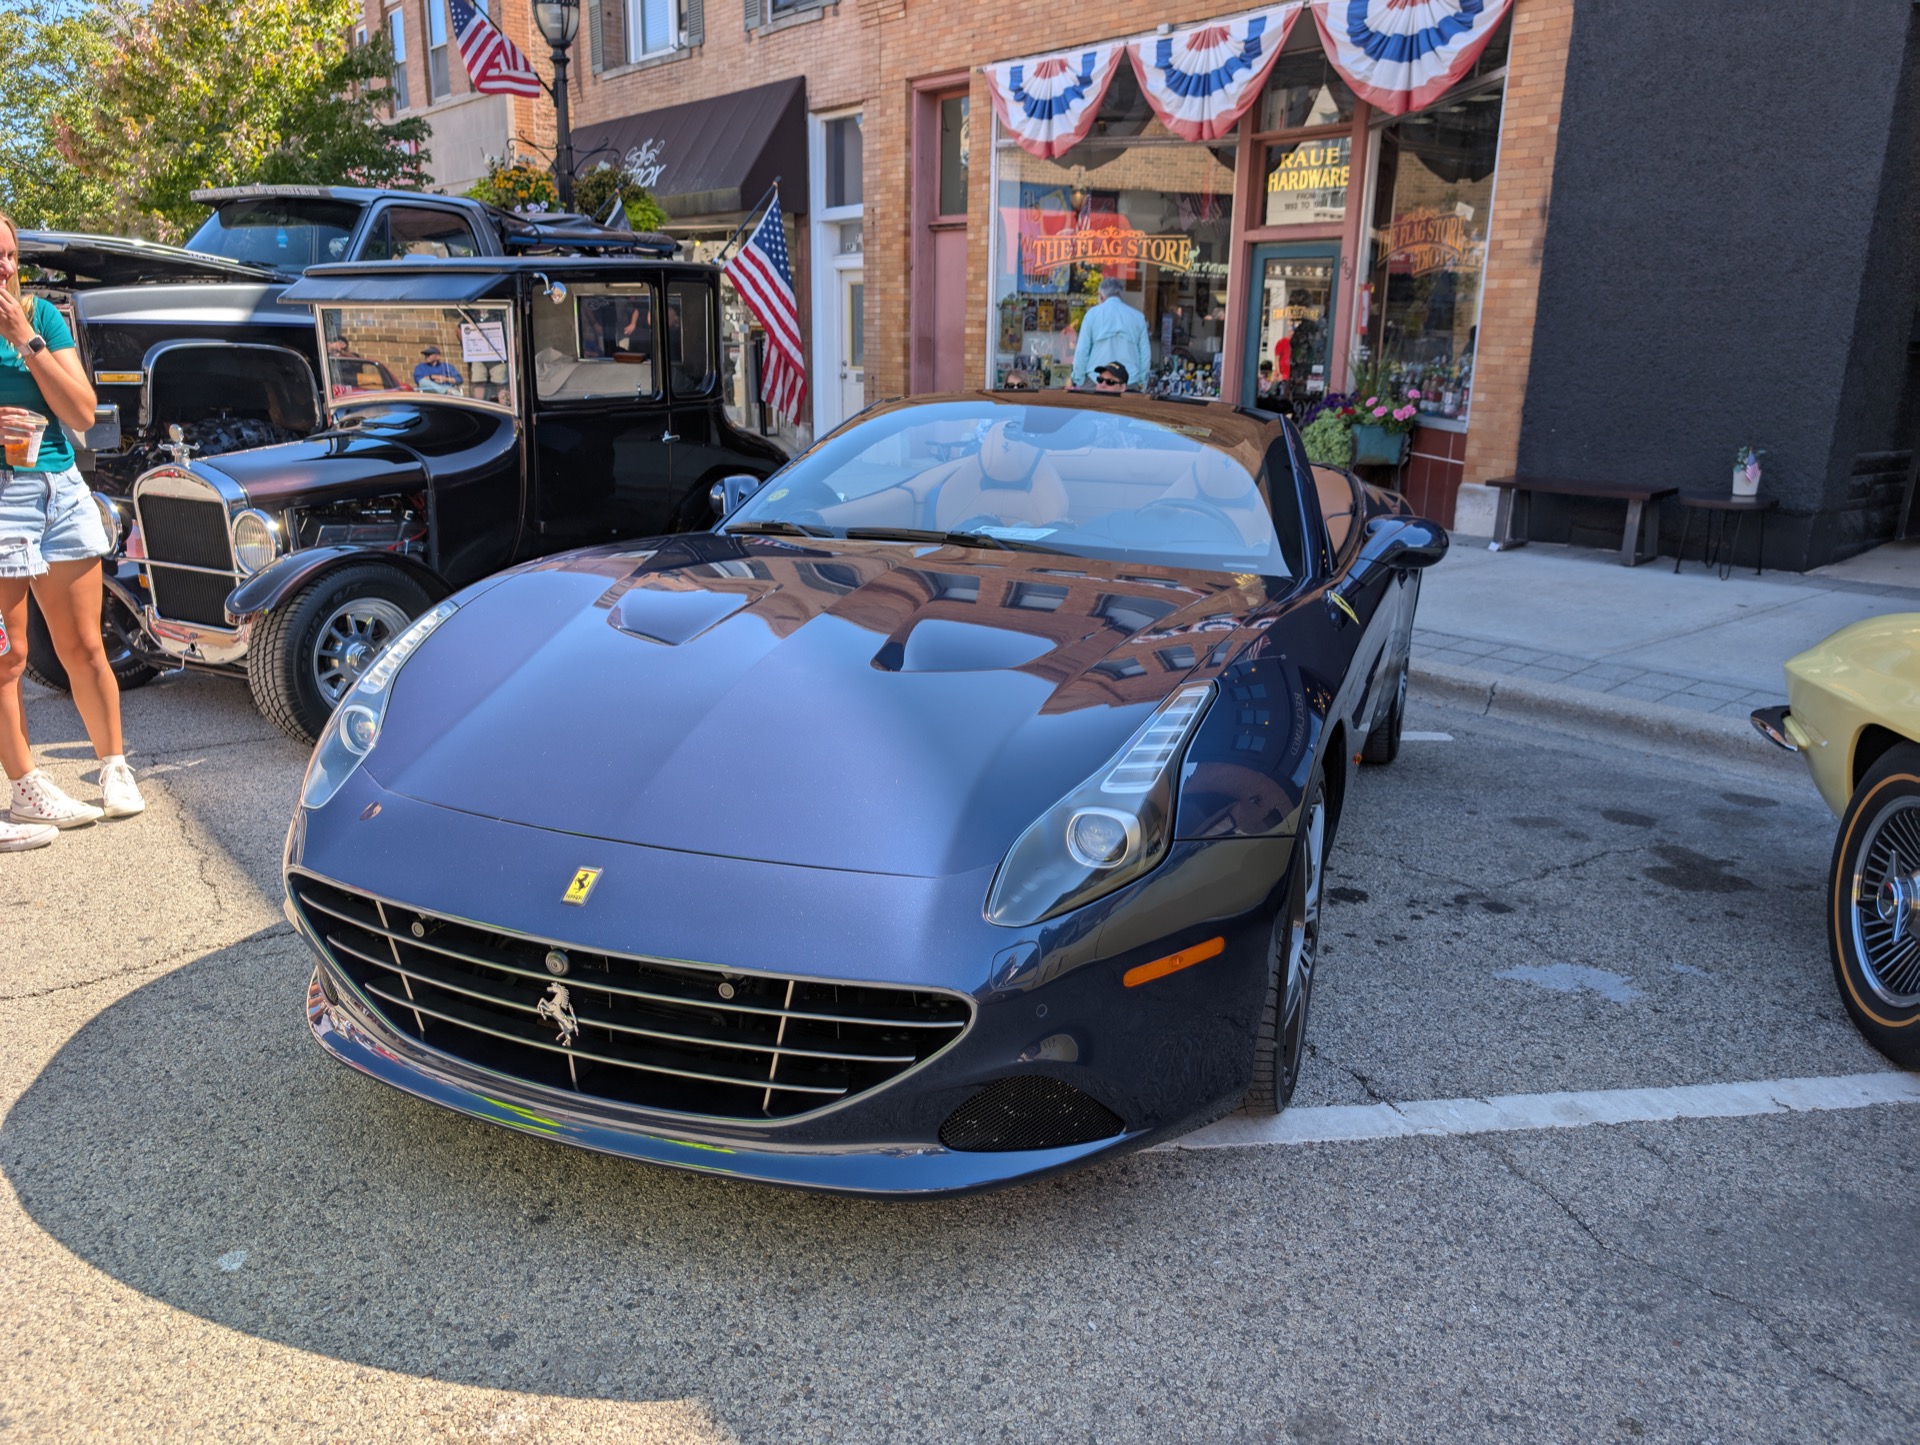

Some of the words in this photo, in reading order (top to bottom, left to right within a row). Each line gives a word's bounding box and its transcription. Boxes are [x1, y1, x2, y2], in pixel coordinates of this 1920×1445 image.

[1280, 147, 1340, 169] RAUE
[1267, 165, 1350, 192] HARDWARE
[1377, 228, 1399, 261] THE
[1399, 221, 1426, 247] FLAG
[1426, 215, 1467, 255] STORE
[1032, 238, 1072, 267] THE
[1075, 237, 1123, 257] FLAG
[1126, 237, 1192, 270] STORE
[1340, 255, 1352, 281] 69
